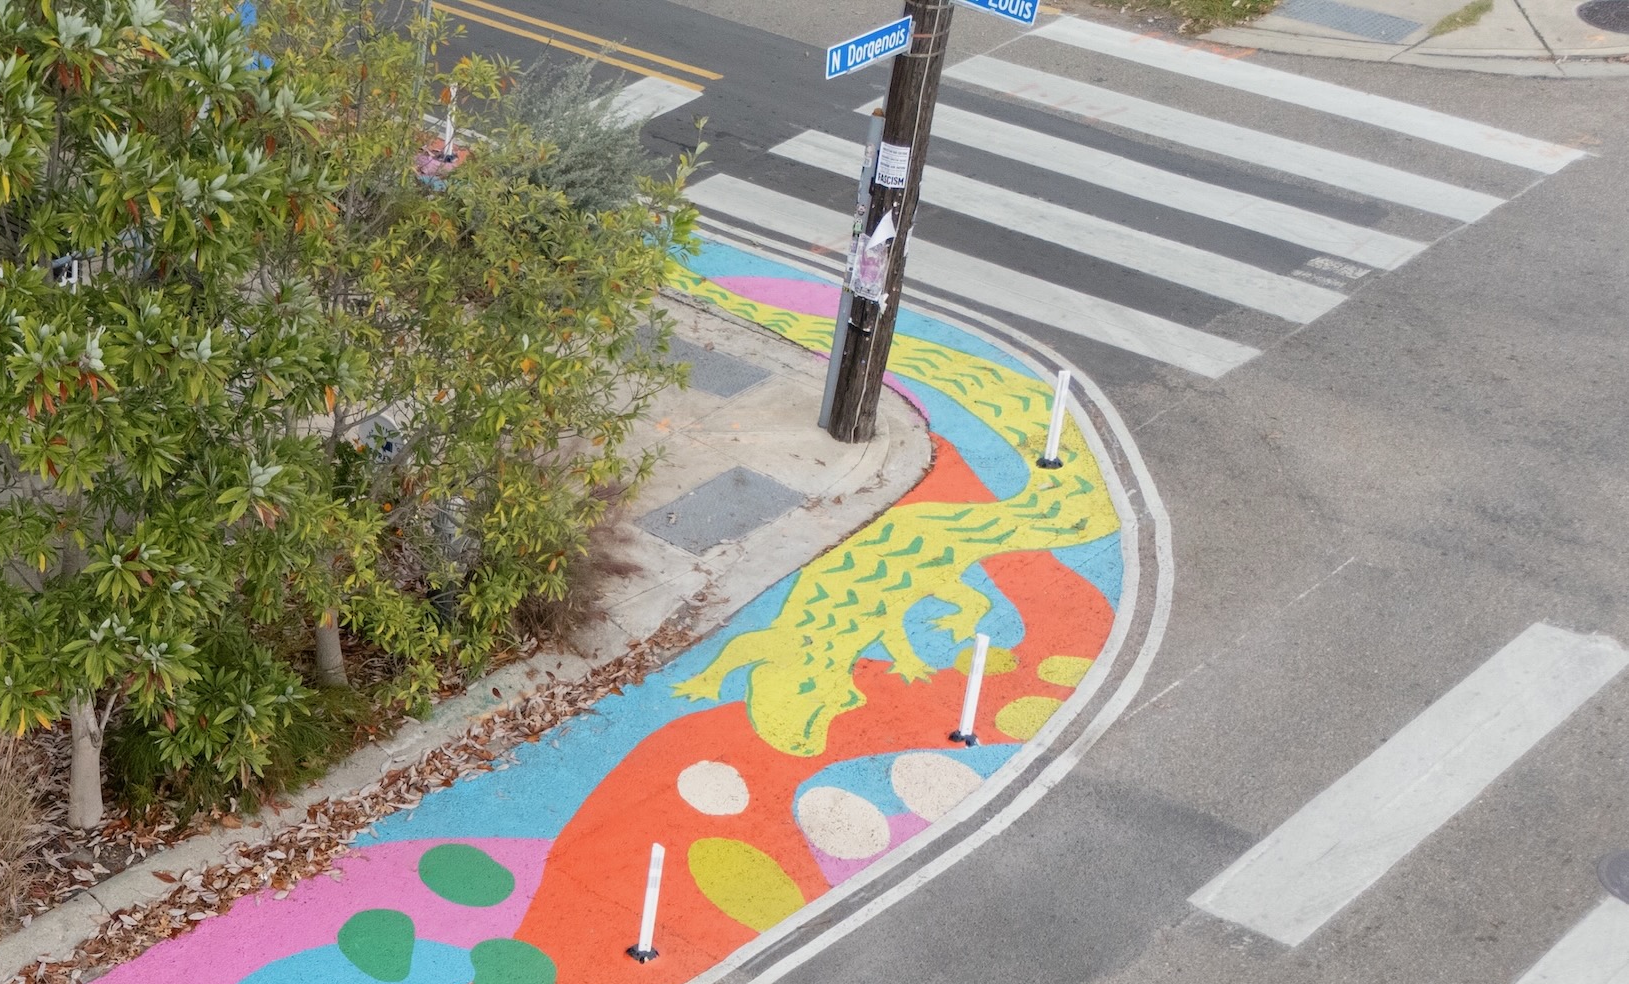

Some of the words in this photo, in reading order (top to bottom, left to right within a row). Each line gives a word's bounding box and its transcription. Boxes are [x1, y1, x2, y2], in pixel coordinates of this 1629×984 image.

[831, 49, 841, 73] N
[847, 25, 906, 67] Dorgenois
[877, 172, 905, 187] FASCISM
